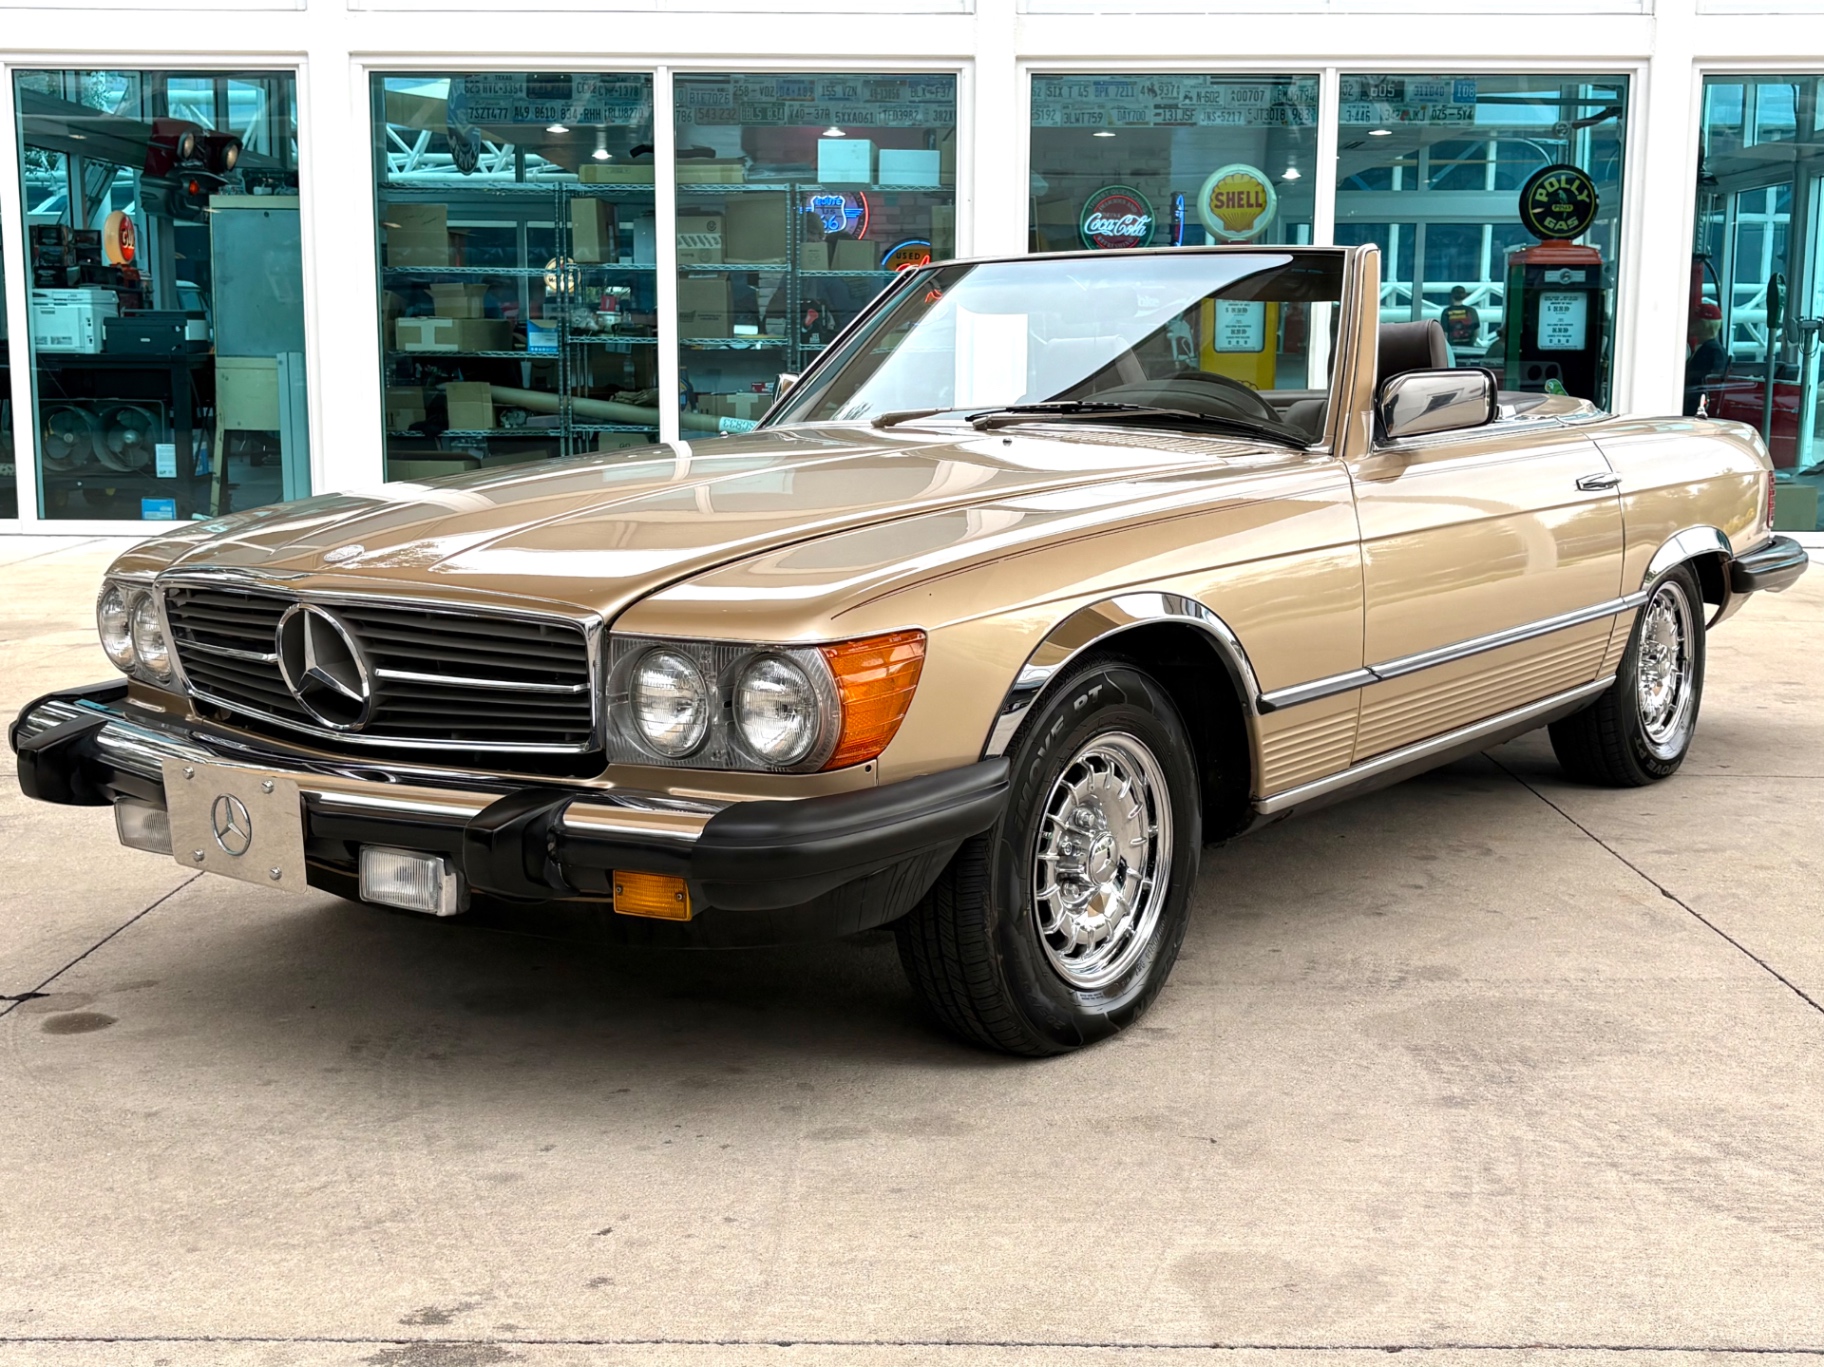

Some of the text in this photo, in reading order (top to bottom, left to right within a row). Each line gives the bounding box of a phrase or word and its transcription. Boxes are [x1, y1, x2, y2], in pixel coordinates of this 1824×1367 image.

[1535, 175, 1589, 203] POLLY
[814, 198, 843, 206] ROUTE
[1214, 191, 1263, 209] SHELL
[1084, 212, 1152, 236] Coca-Cola
[1543, 216, 1579, 230] GAS
[896, 252, 921, 260] USED
